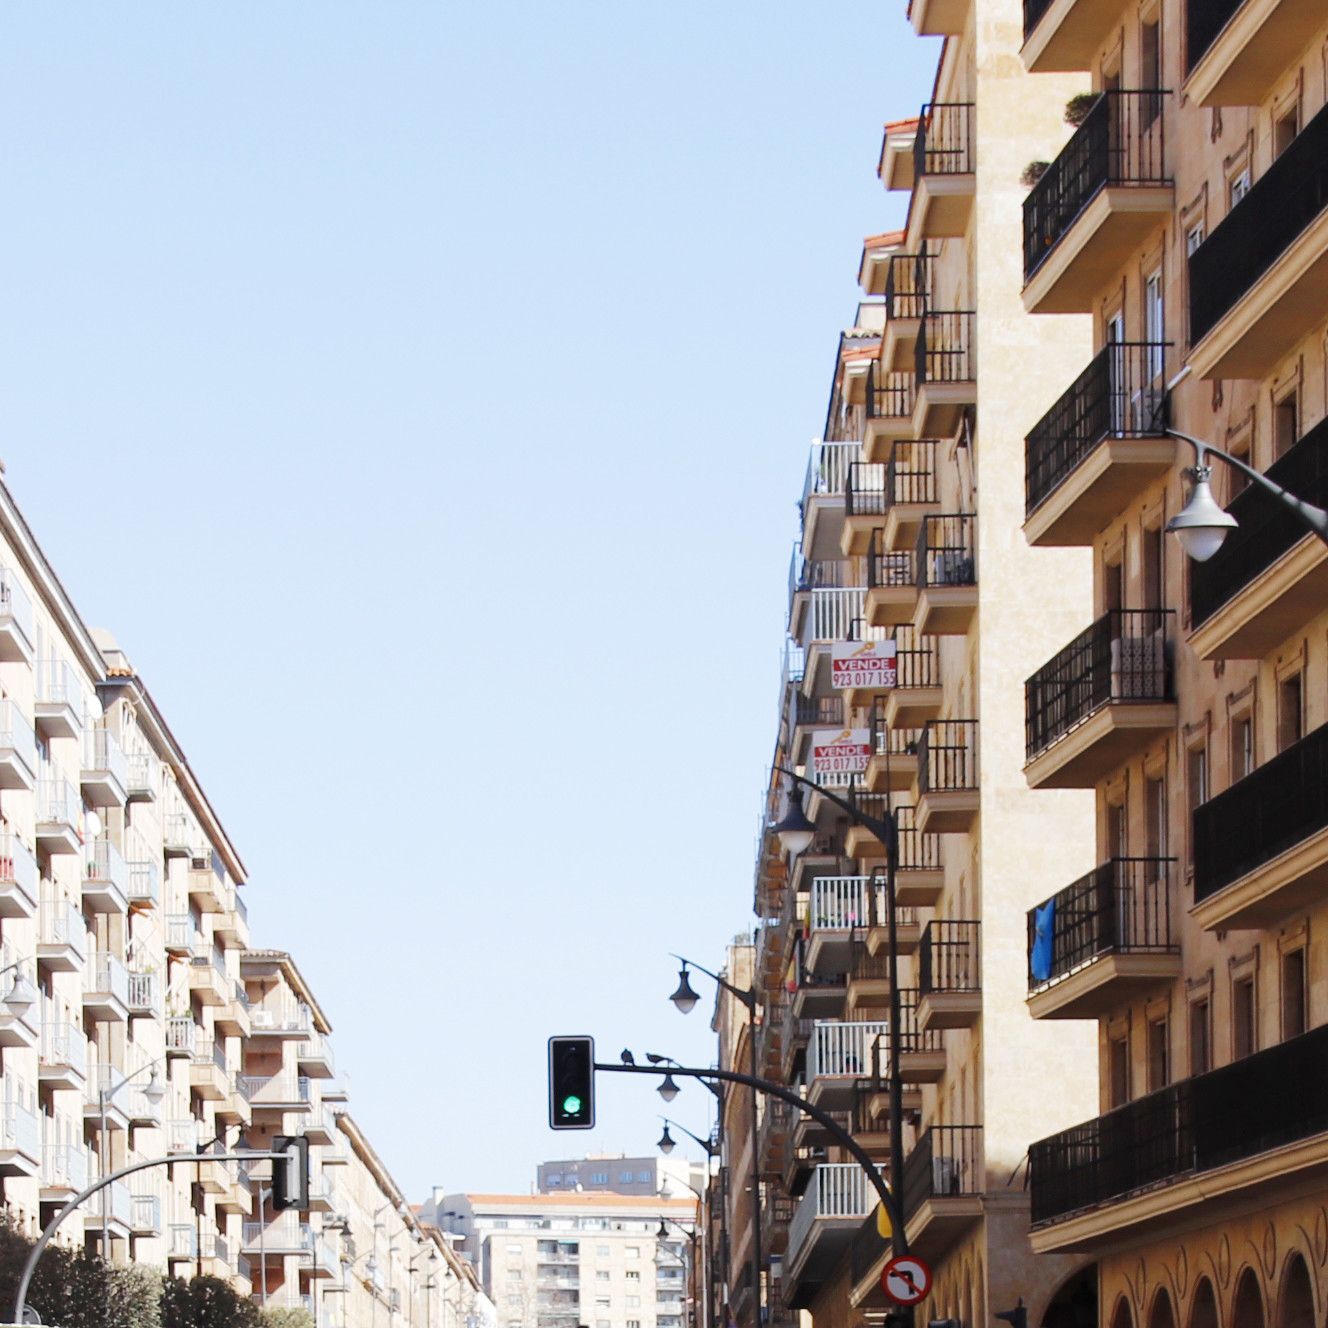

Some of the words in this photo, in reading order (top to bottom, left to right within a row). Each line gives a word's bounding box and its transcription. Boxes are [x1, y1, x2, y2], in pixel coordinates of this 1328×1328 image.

[838, 661, 890, 670] VENDE
[833, 673, 852, 686] 923
[855, 673, 873, 685] 017
[878, 672, 895, 685] 155
[819, 747, 864, 756] VENDE
[815, 759, 831, 771] 923
[833, 759, 850, 770] 017
